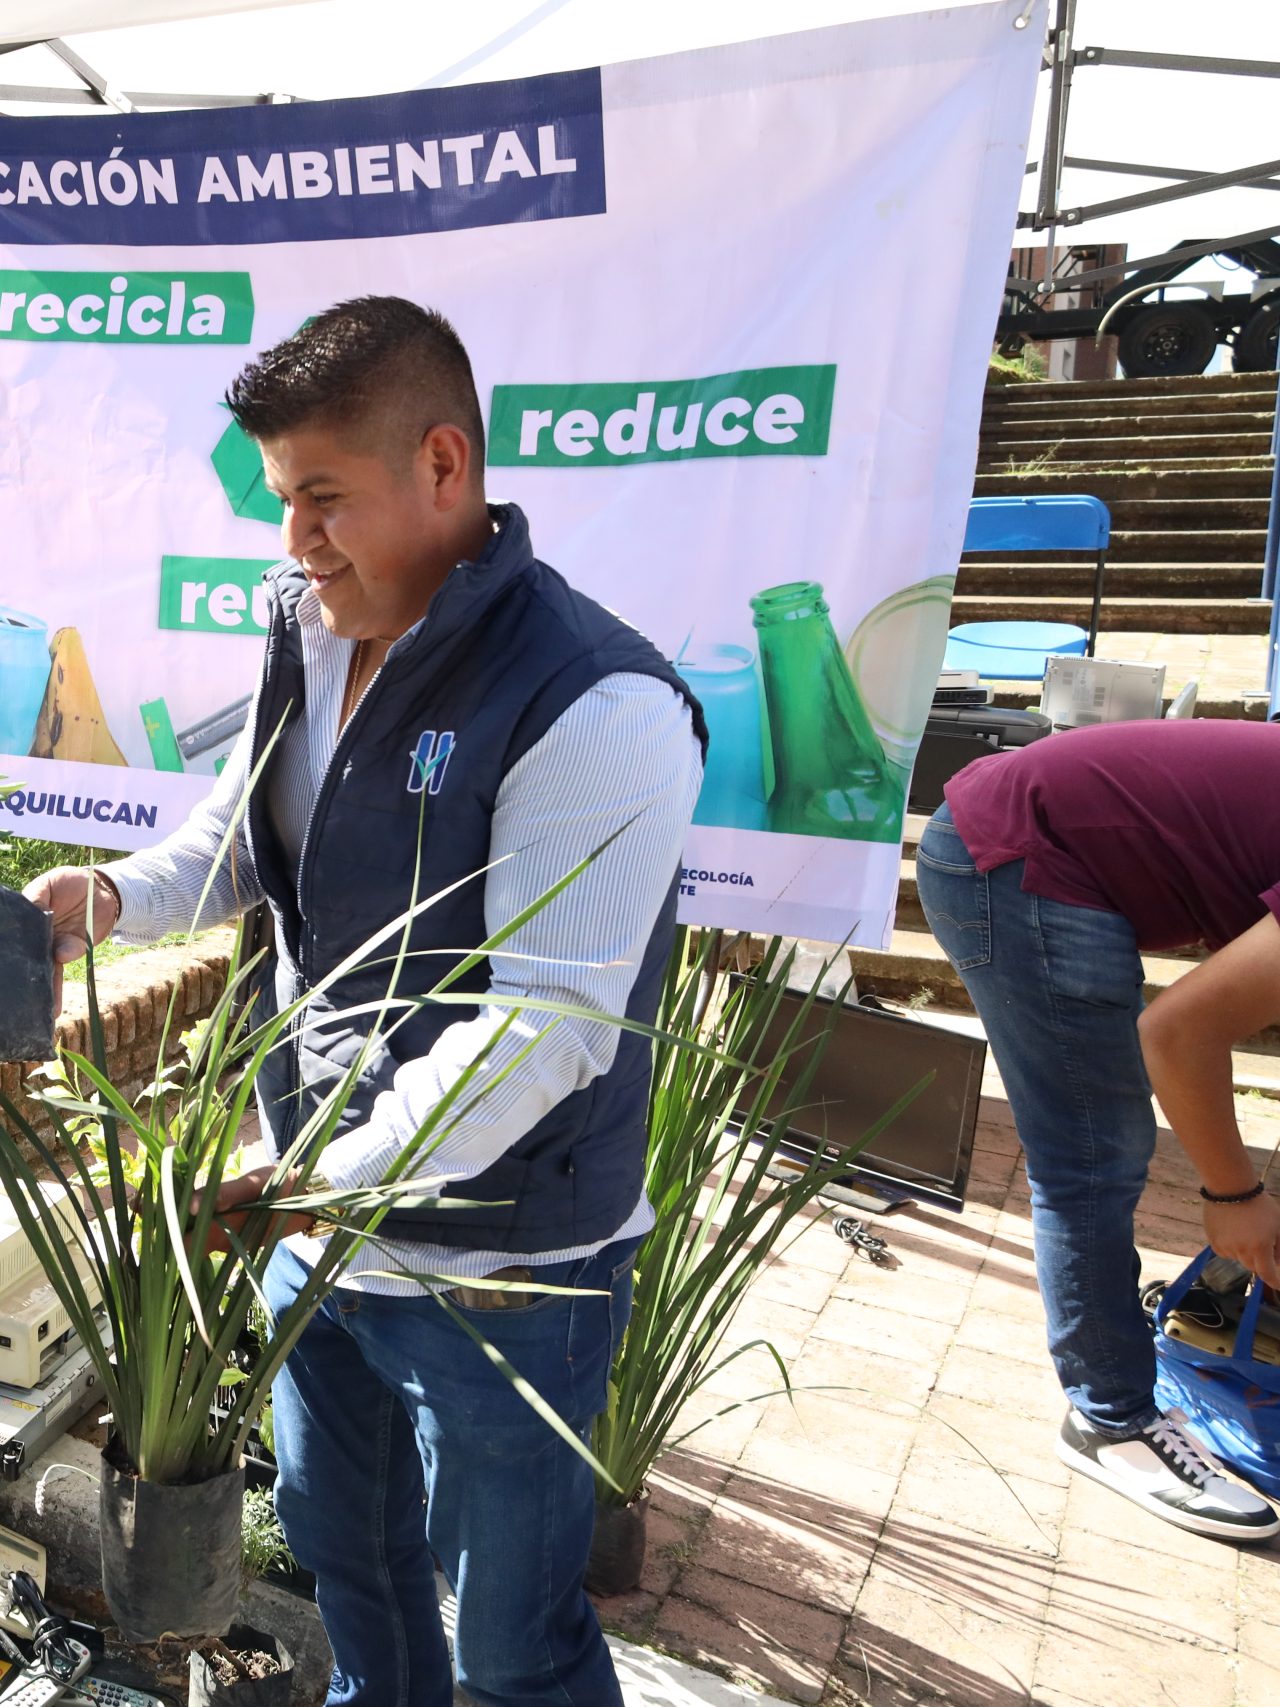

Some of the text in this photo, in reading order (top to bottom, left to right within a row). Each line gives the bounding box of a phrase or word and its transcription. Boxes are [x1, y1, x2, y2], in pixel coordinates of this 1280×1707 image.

[197, 125, 577, 204] AMBIENTAL
[519, 392, 805, 456] reduce
[680, 868, 754, 887] ECOLOGÍA
